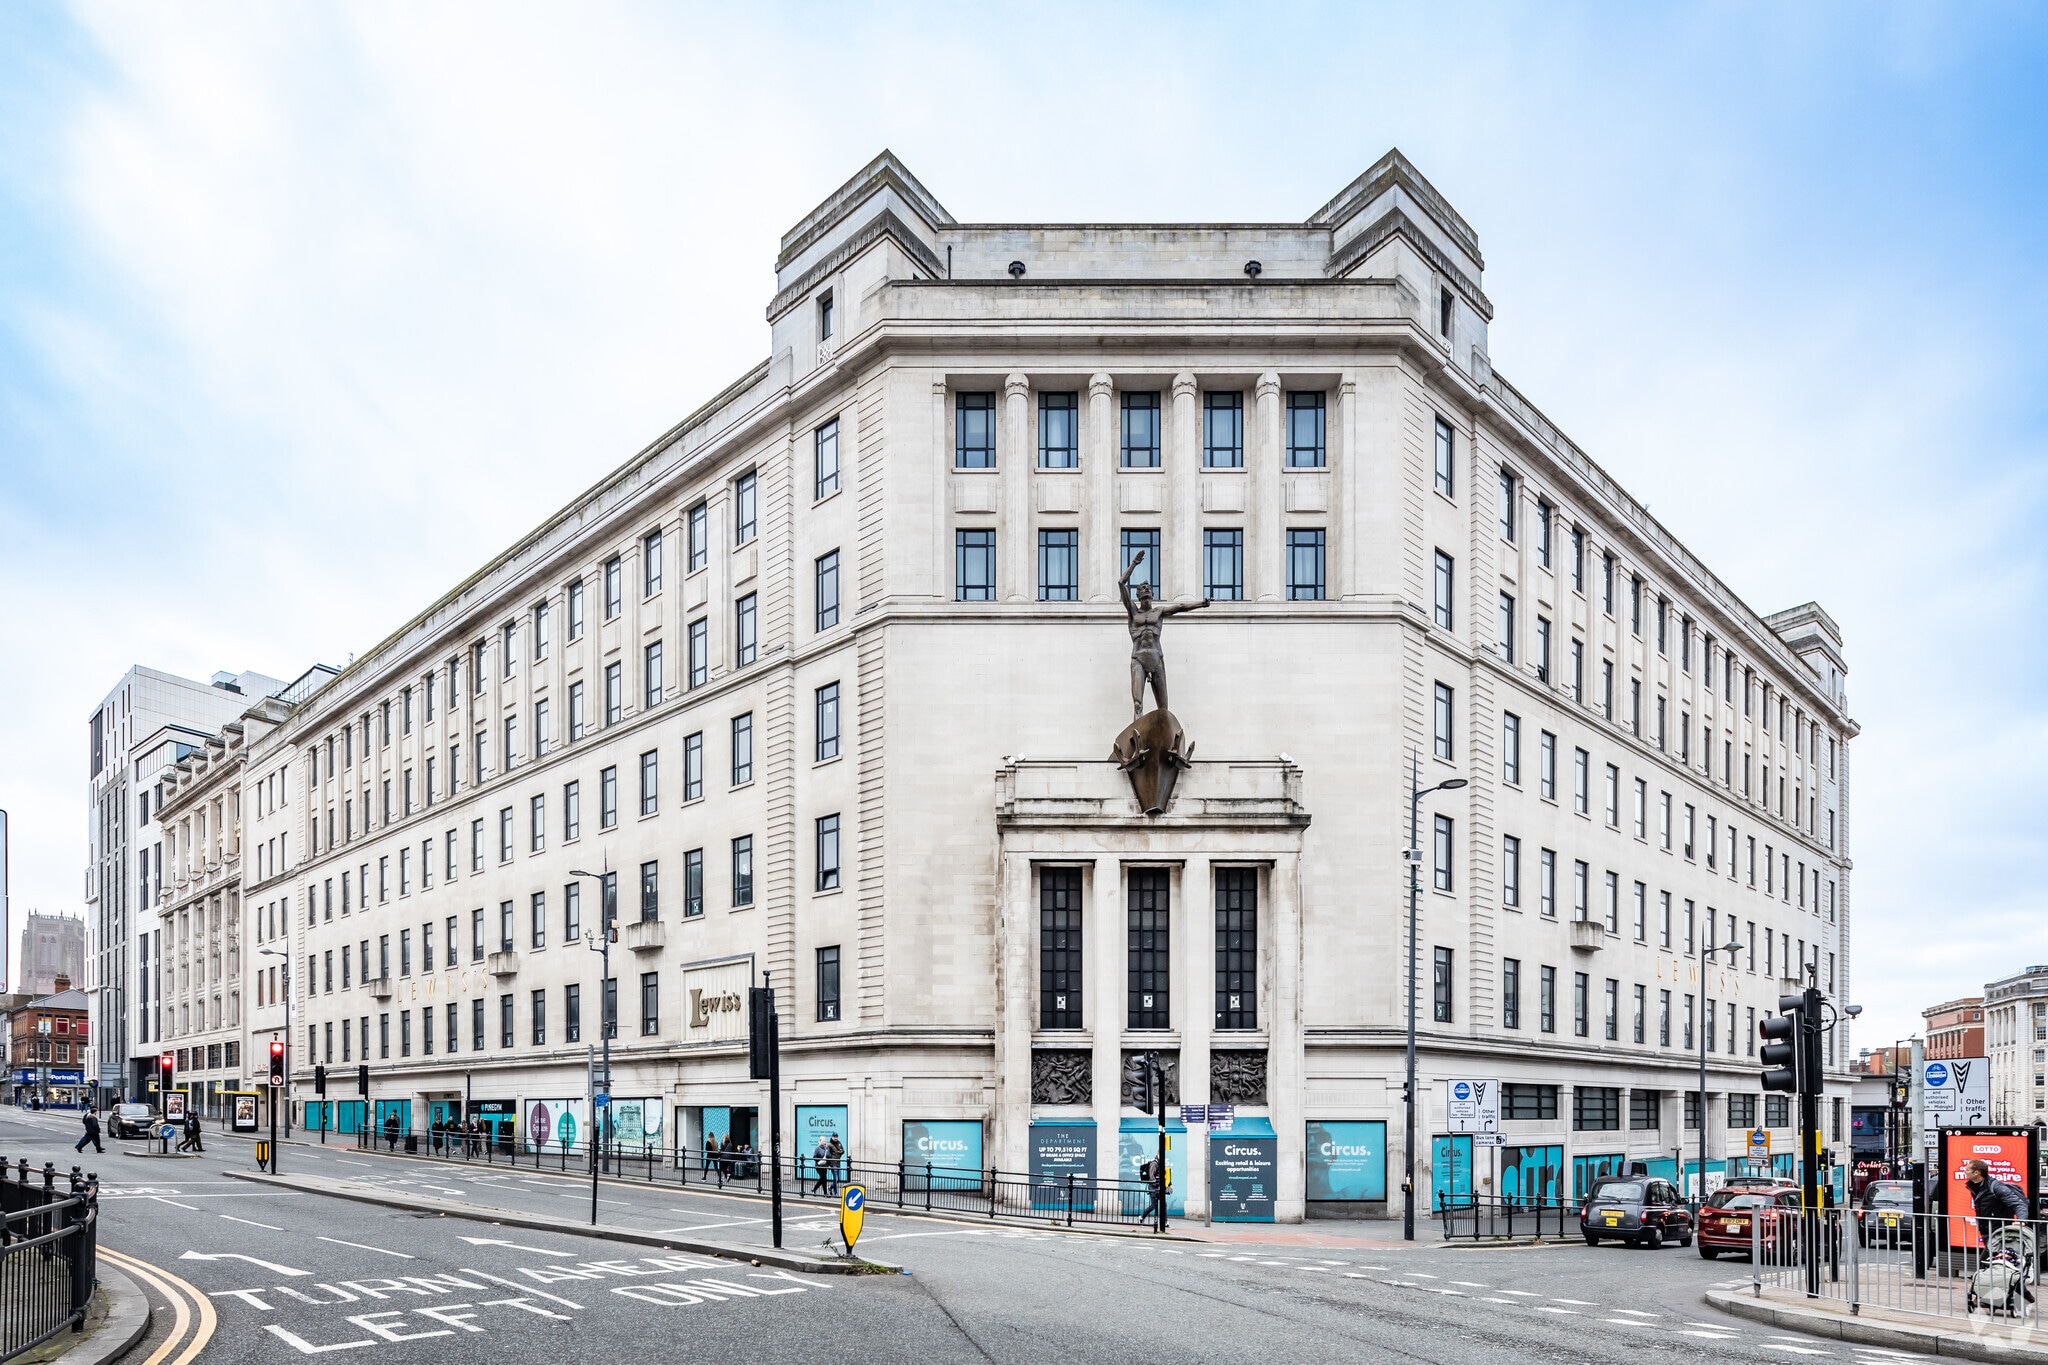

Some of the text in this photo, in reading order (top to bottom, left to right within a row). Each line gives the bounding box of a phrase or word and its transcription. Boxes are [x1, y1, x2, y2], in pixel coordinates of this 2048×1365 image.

[397, 967, 488, 1004] LEWIS'S
[1657, 955, 1740, 997] LEWIS'S
[689, 988, 742, 1028] Lewis's
[808, 1115, 836, 1127] Circus.
[918, 1135, 968, 1151] Circus.
[1224, 1144, 1262, 1156] Circus.
[1321, 1140, 1371, 1156] Circus.
[516, 1255, 746, 1284] AHEAD
[208, 1273, 489, 1311] TURN
[610, 1271, 833, 1307] ONLY
[263, 1297, 573, 1354] LEFT
